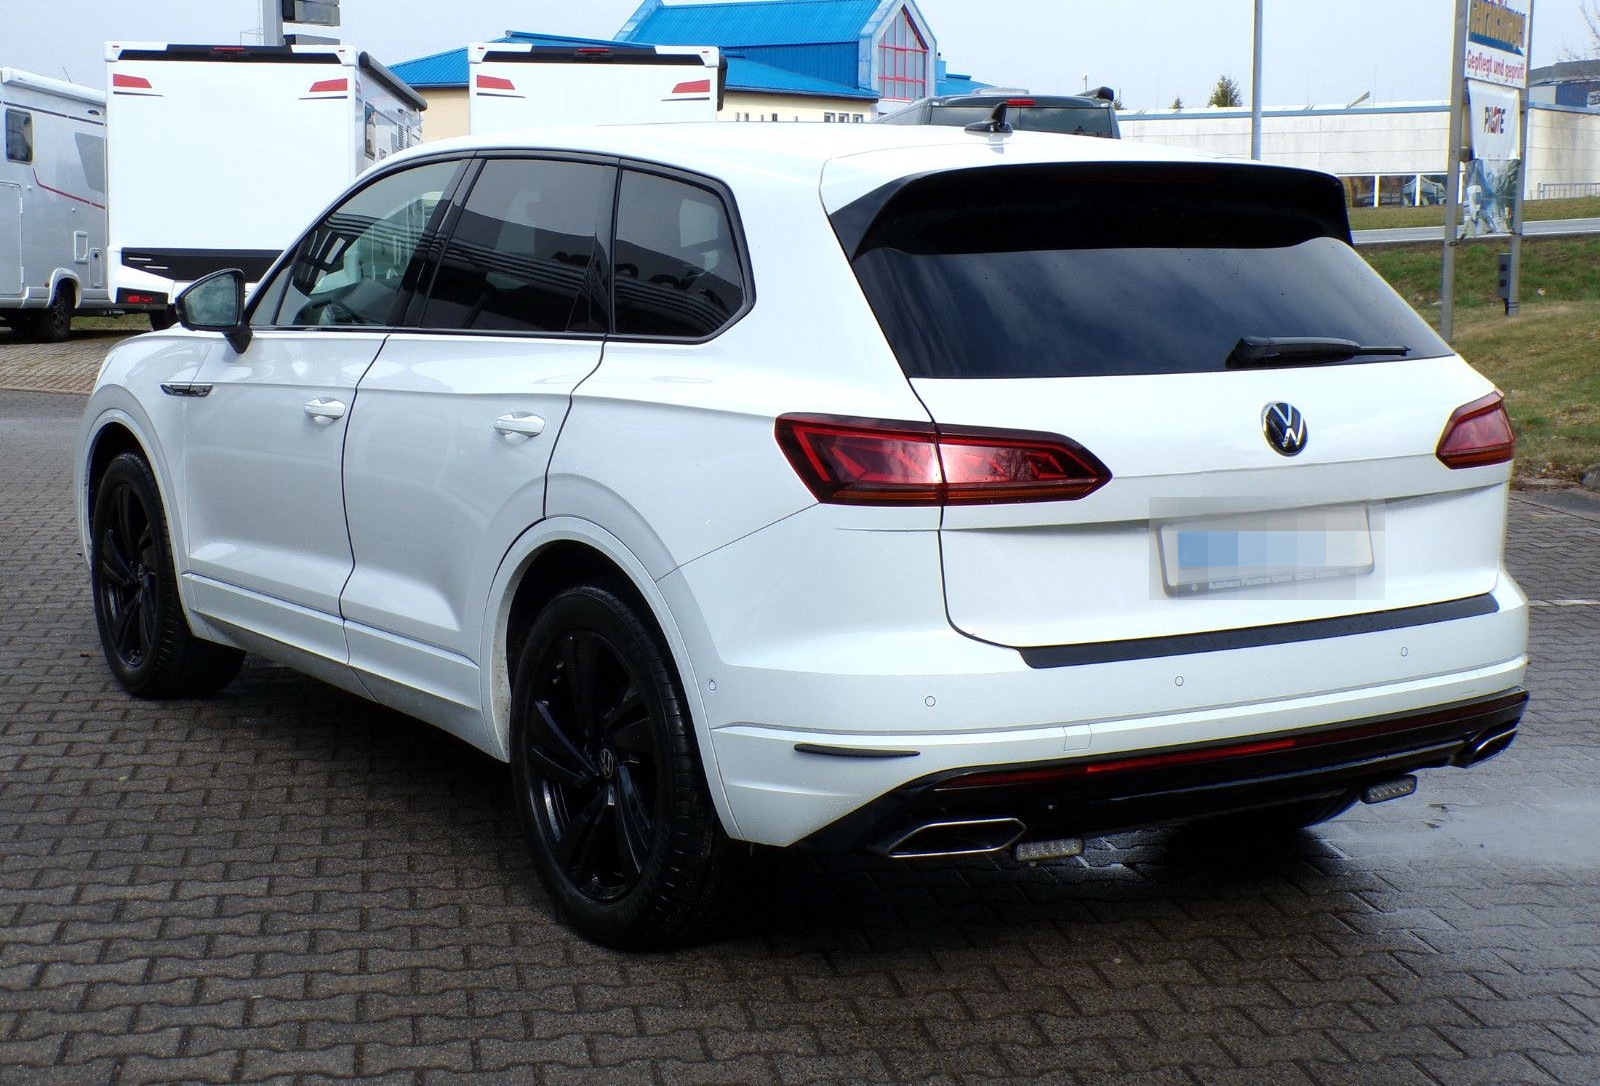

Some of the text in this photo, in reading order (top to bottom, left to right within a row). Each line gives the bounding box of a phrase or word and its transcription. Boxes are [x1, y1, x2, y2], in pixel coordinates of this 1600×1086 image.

[1467, 49, 1492, 79] Gepflegt
[1493, 58, 1505, 77] und
[1208, 580, 1241, 590] Autohaus
[1241, 576, 1271, 587] Fleischer
[1272, 573, 1292, 584] GmbH
